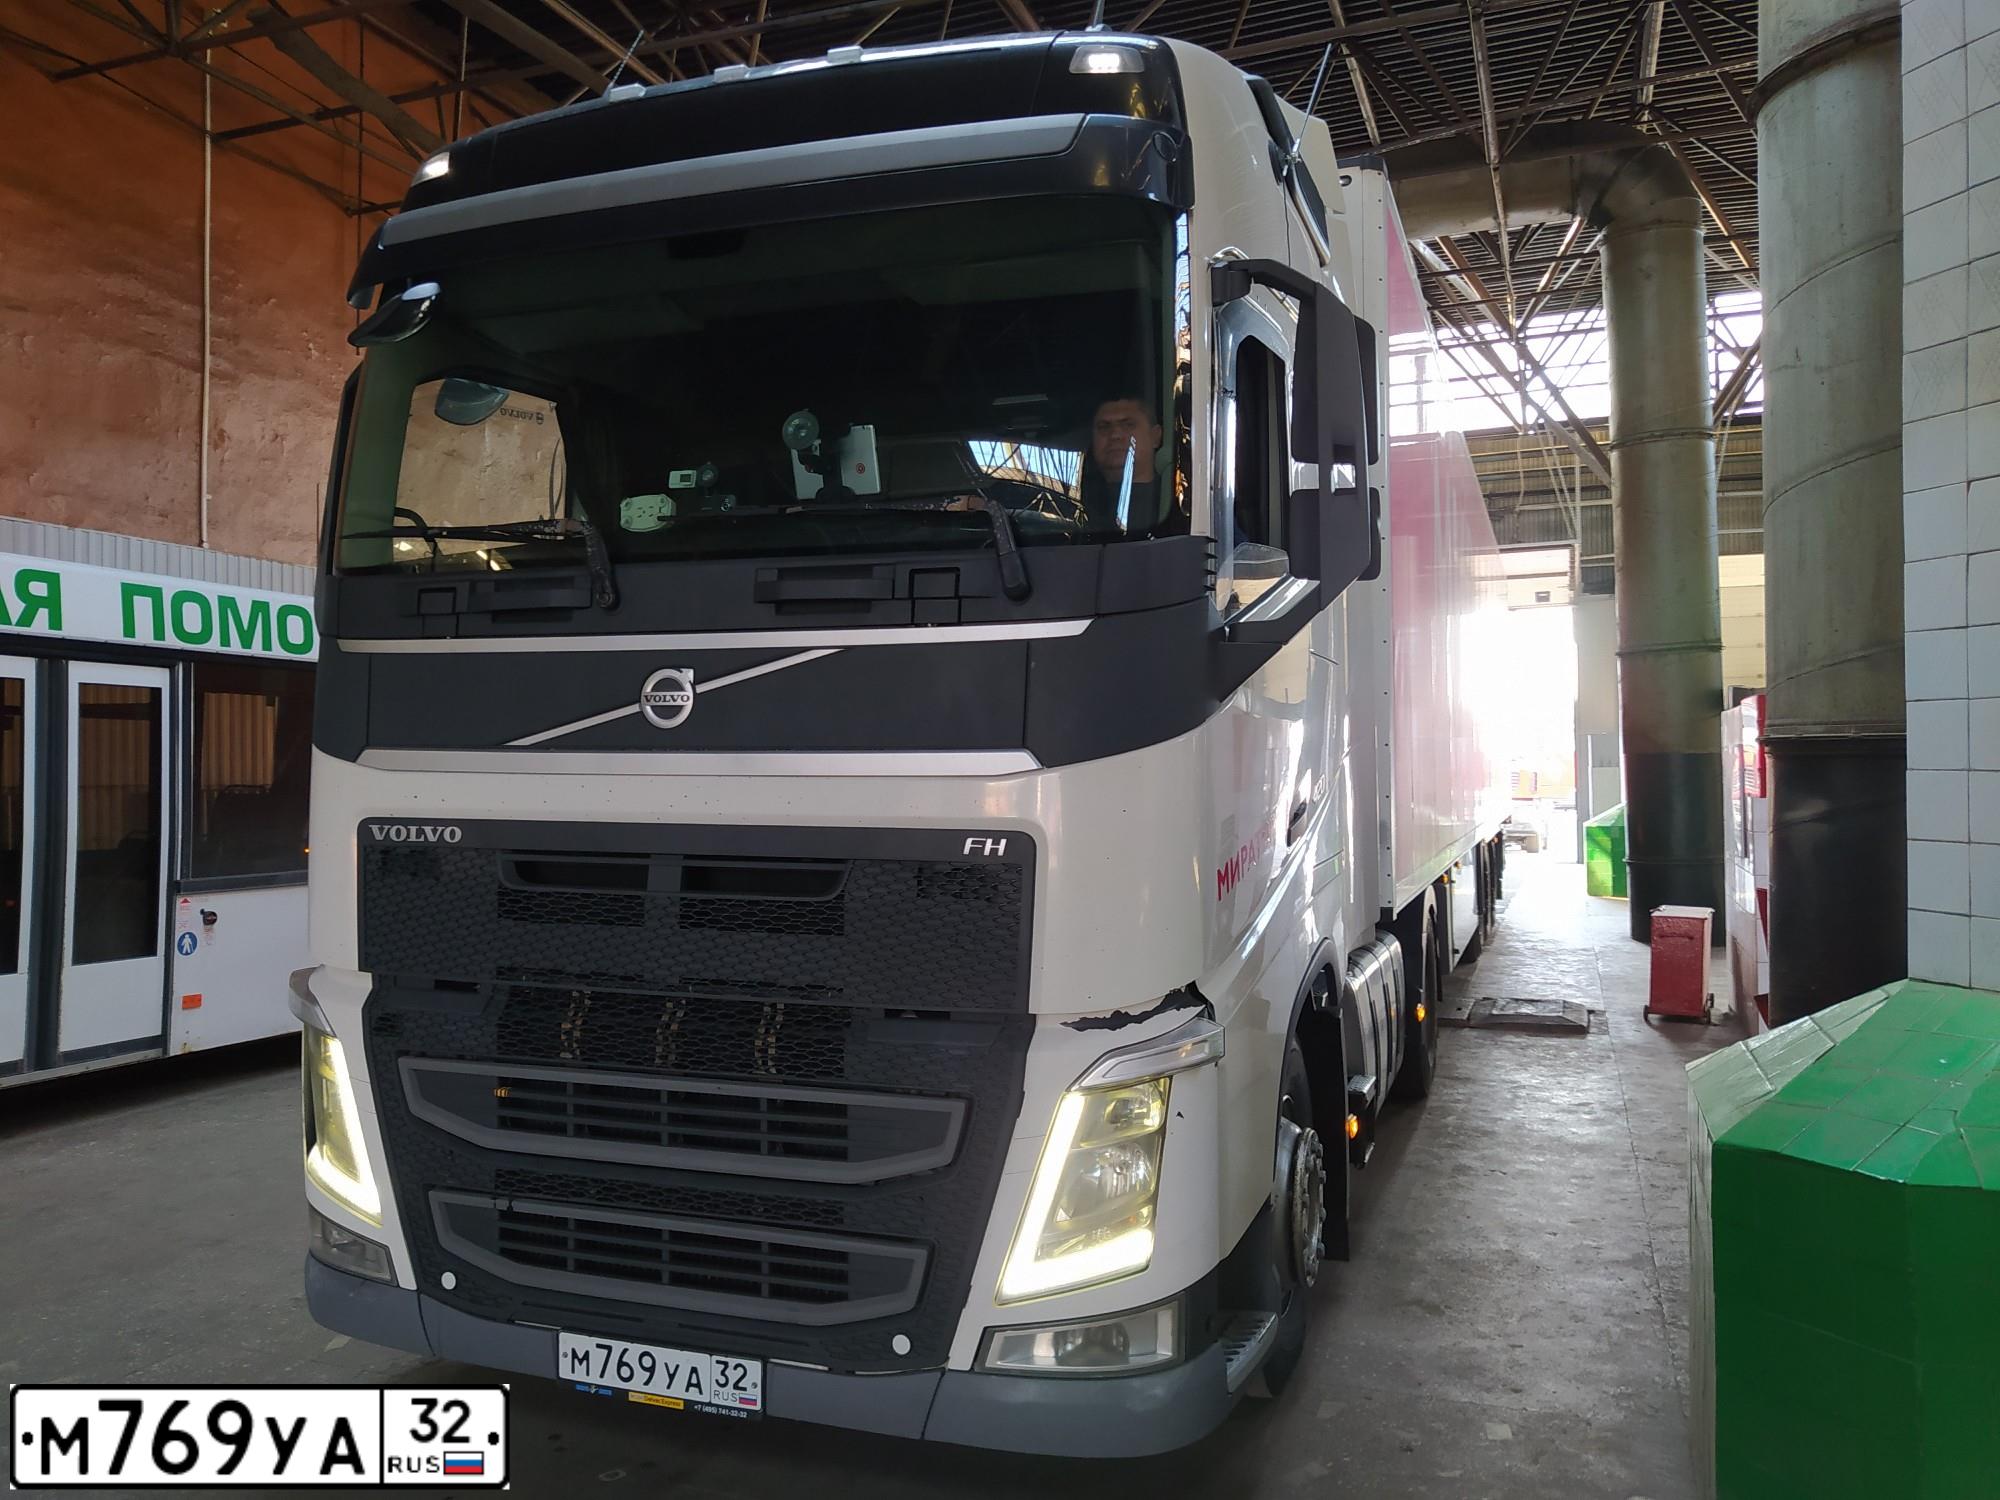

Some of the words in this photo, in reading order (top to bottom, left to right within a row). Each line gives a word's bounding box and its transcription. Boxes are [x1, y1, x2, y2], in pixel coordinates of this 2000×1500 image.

[643, 694, 690, 703] VOLVO
[368, 824, 462, 843] VOLVO
[963, 837, 1007, 856] FH
[715, 1359, 748, 1392] 32
[713, 1389, 738, 1402] RUS
